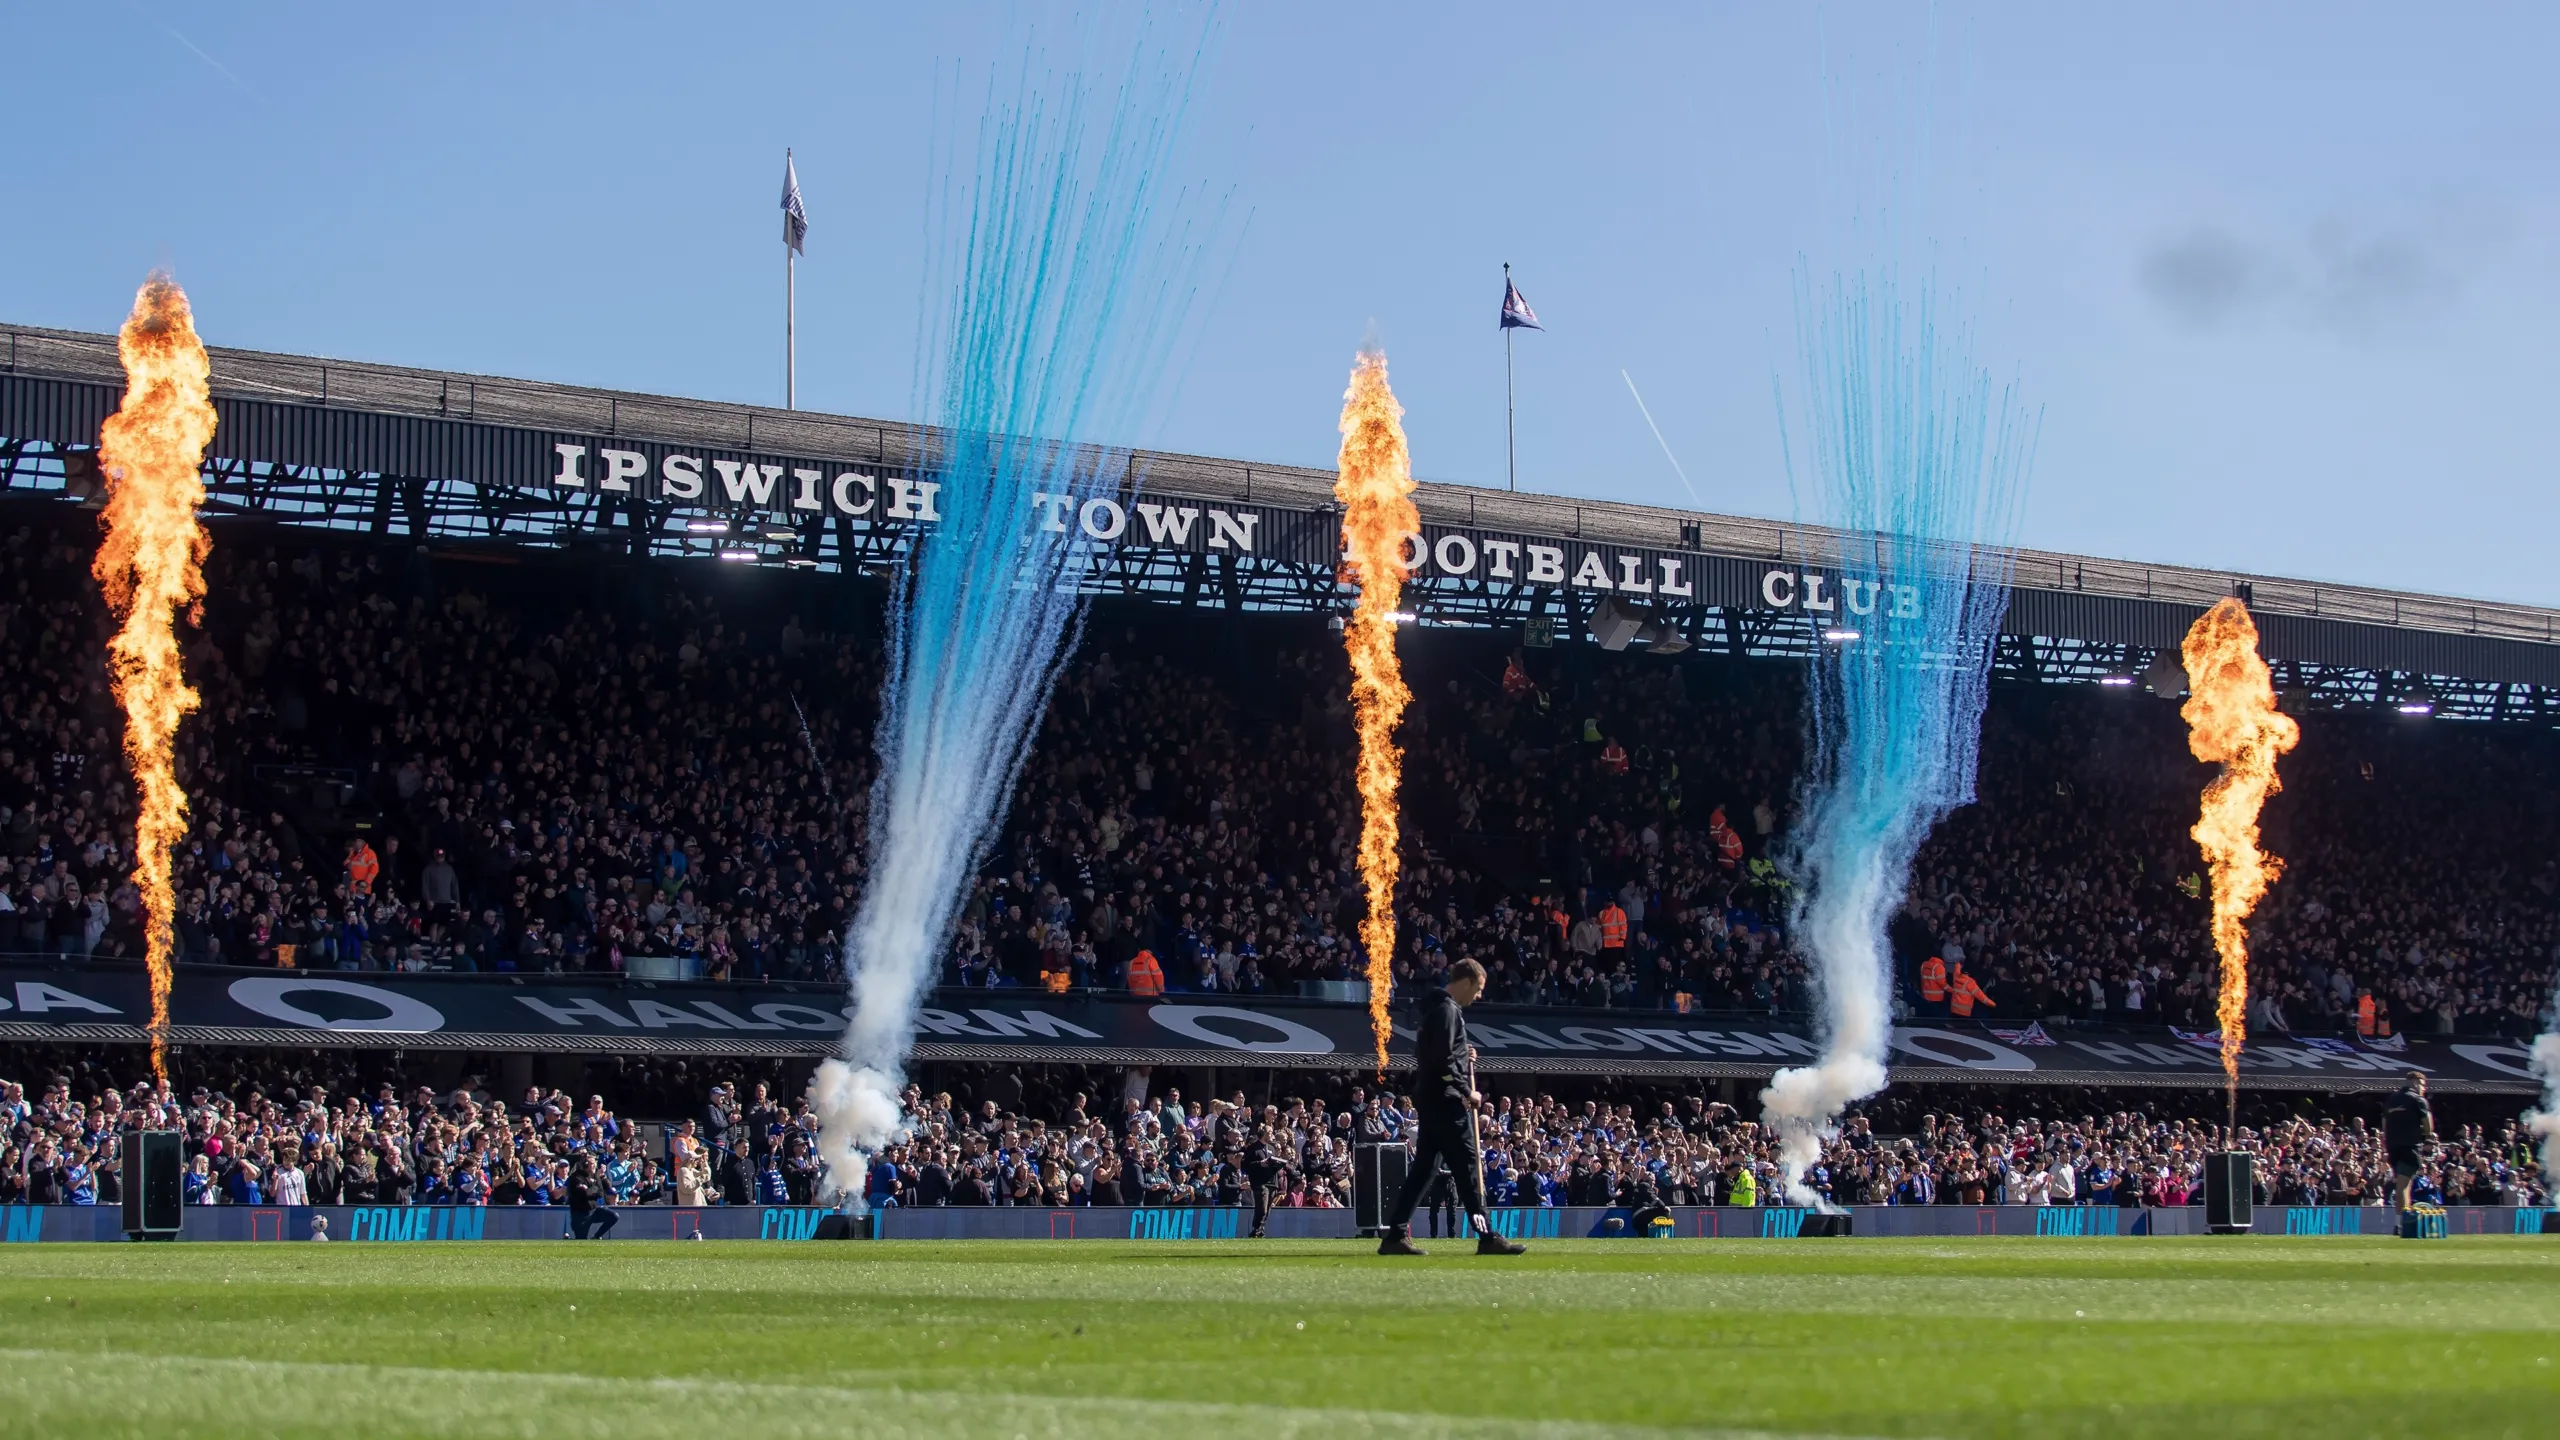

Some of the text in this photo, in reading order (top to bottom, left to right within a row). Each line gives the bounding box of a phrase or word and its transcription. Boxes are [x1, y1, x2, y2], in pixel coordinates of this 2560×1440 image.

[554, 443, 1922, 620] IPSWICH TOWN OOTBALL CLUB
[1527, 619, 1552, 629] EXIT
[512, 996, 1104, 1038] HALORM
[172, 1045, 182, 1054] 22
[774, 1058, 784, 1067] 19
[1497, 1187, 1507, 1202] 2
[351, 1207, 487, 1241] COME IN
[1130, 1208, 1239, 1239] COME IN
[1524, 1209, 1561, 1238] IN
[2037, 1207, 2118, 1237] COME IN
[2286, 1207, 2361, 1236] COME IN
